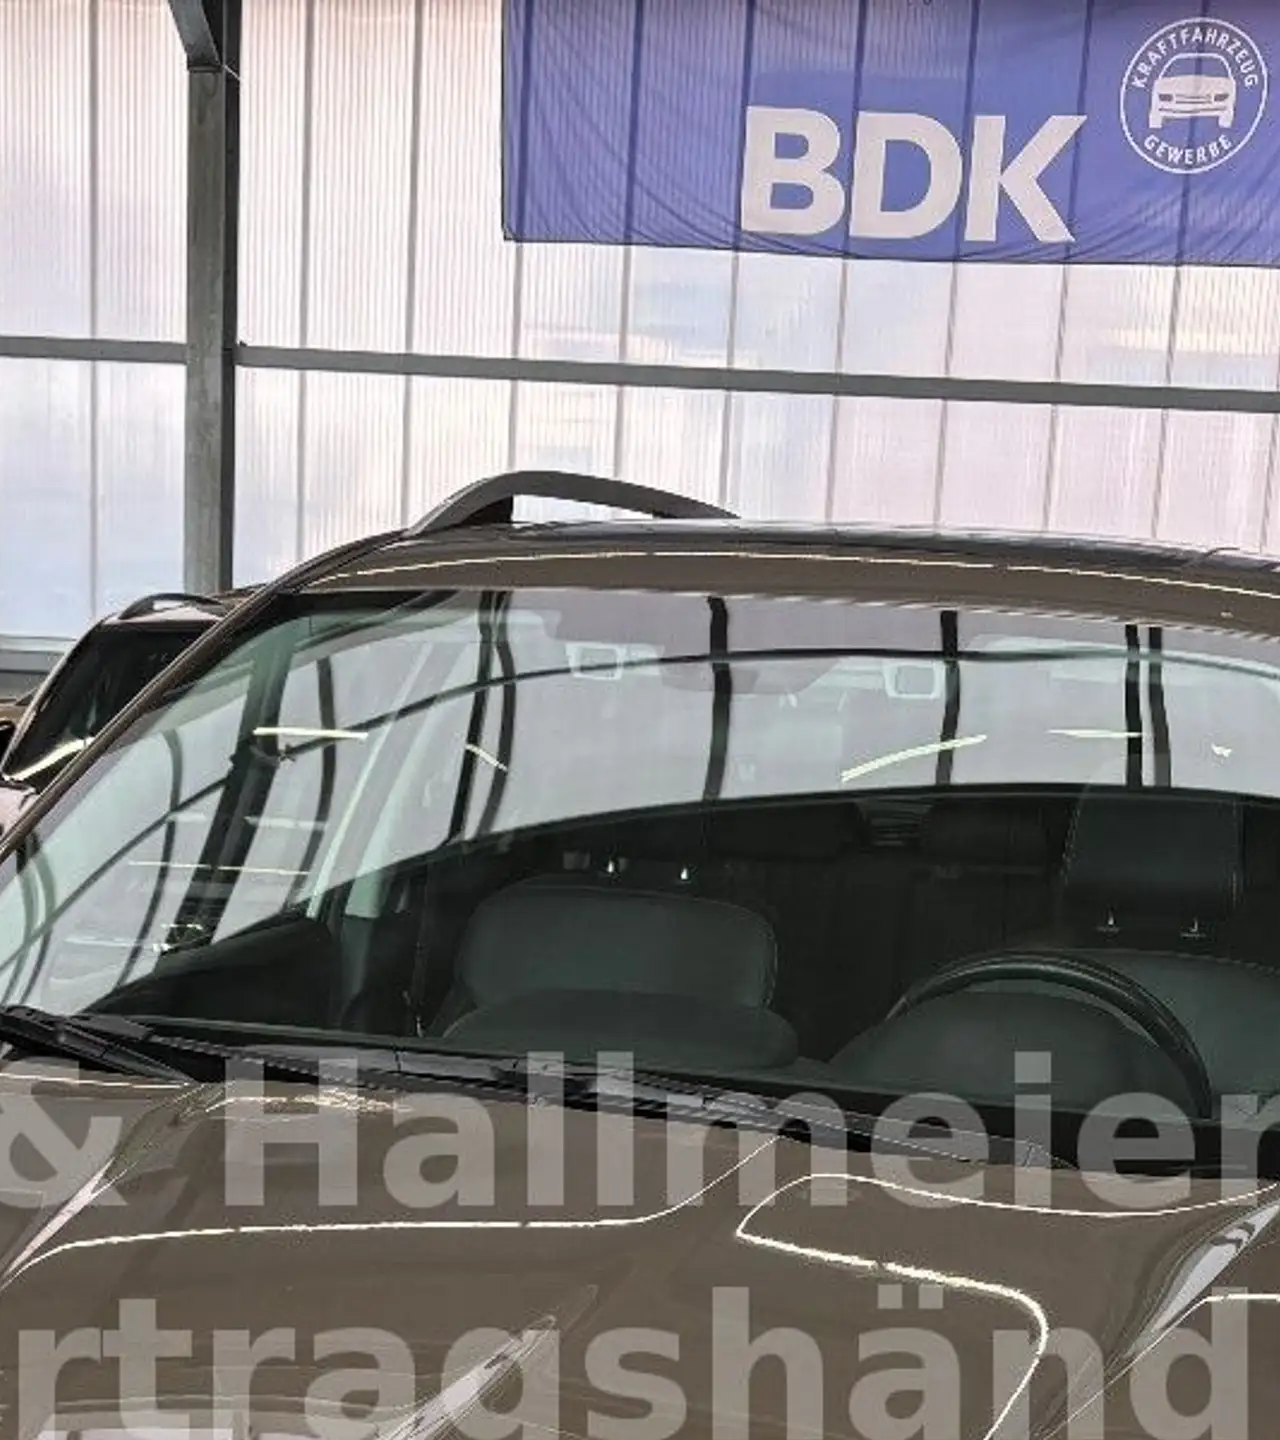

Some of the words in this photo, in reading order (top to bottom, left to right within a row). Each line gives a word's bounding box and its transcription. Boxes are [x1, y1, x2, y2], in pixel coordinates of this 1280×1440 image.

[1131, 26, 1259, 89] KRAFTFAHRZEUG
[741, 105, 1088, 243] BDK
[1144, 133, 1233, 165] GEWERBE
